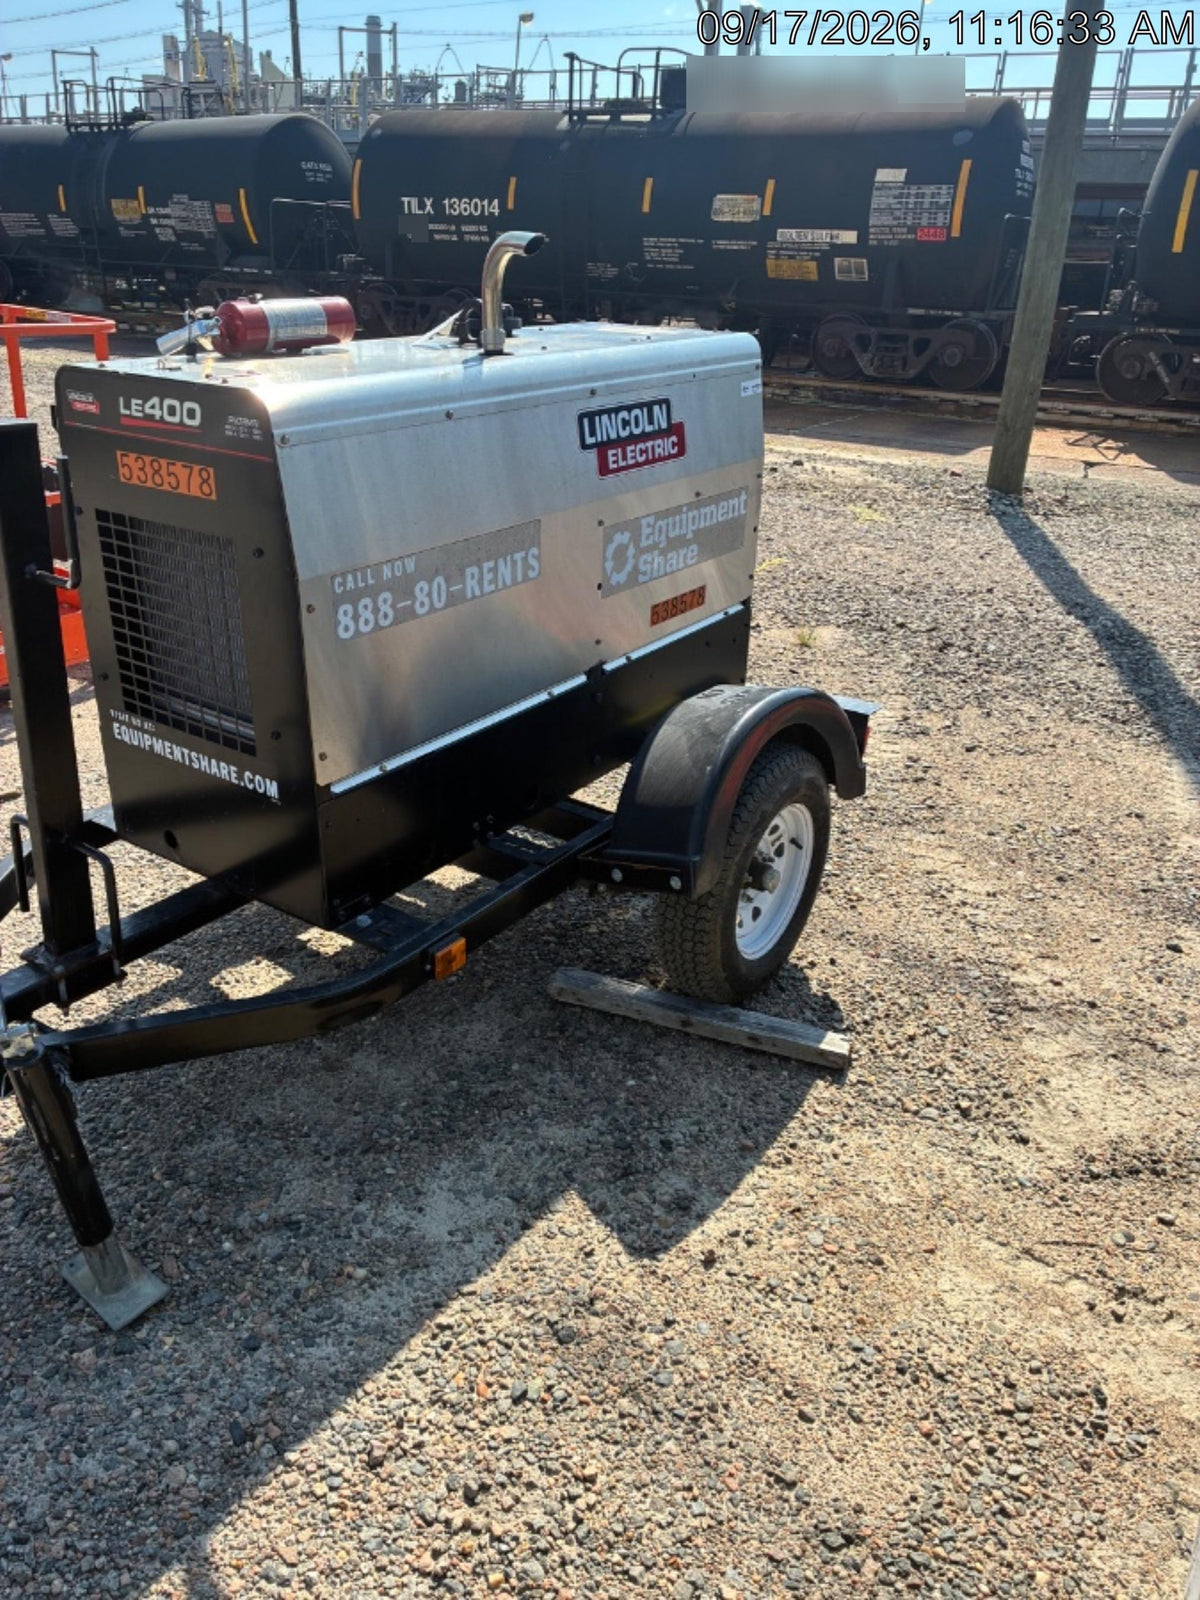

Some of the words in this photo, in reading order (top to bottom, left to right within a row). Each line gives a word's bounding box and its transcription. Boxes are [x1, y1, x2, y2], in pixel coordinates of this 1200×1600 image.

[401, 197, 434, 214] TILX
[442, 198, 500, 216] 136014
[119, 396, 201, 427] LE400
[583, 403, 667, 444] LINCOLN
[607, 435, 678, 470] ELECTRIC
[120, 453, 213, 497] 538578
[640, 490, 748, 548] Equipment
[334, 568, 375, 594] CALL
[383, 555, 416, 580] NOW
[637, 543, 698, 583] Share
[337, 547, 540, 639] 888-80-RENTS
[652, 586, 706, 623] 538578
[112, 722, 279, 799] EQUIPMENTSHARE.COM
